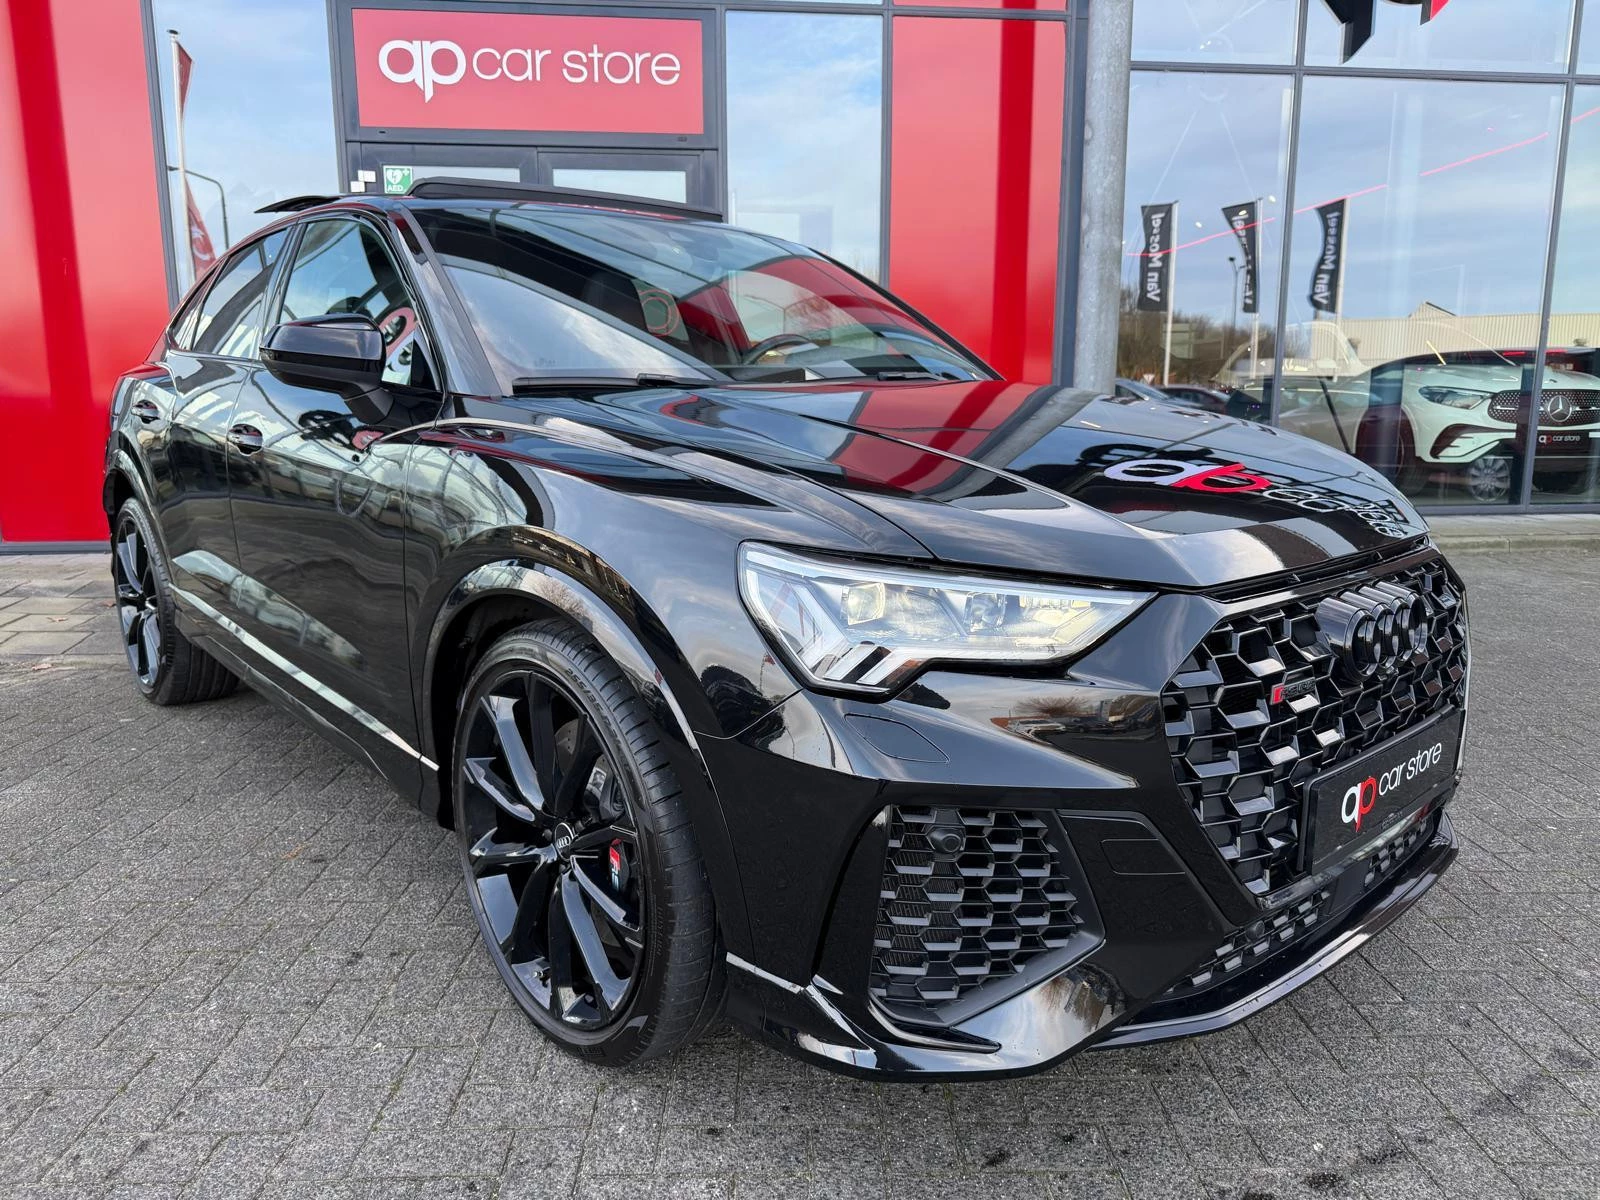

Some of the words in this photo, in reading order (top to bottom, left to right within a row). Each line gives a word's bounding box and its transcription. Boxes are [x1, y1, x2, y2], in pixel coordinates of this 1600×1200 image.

[378, 39, 467, 103] ap
[472, 47, 551, 82] car
[562, 44, 681, 86] store
[387, 184, 404, 192] AED
[1341, 776, 1377, 833] ap
[1378, 761, 1406, 796] car
[1406, 742, 1442, 780] store
